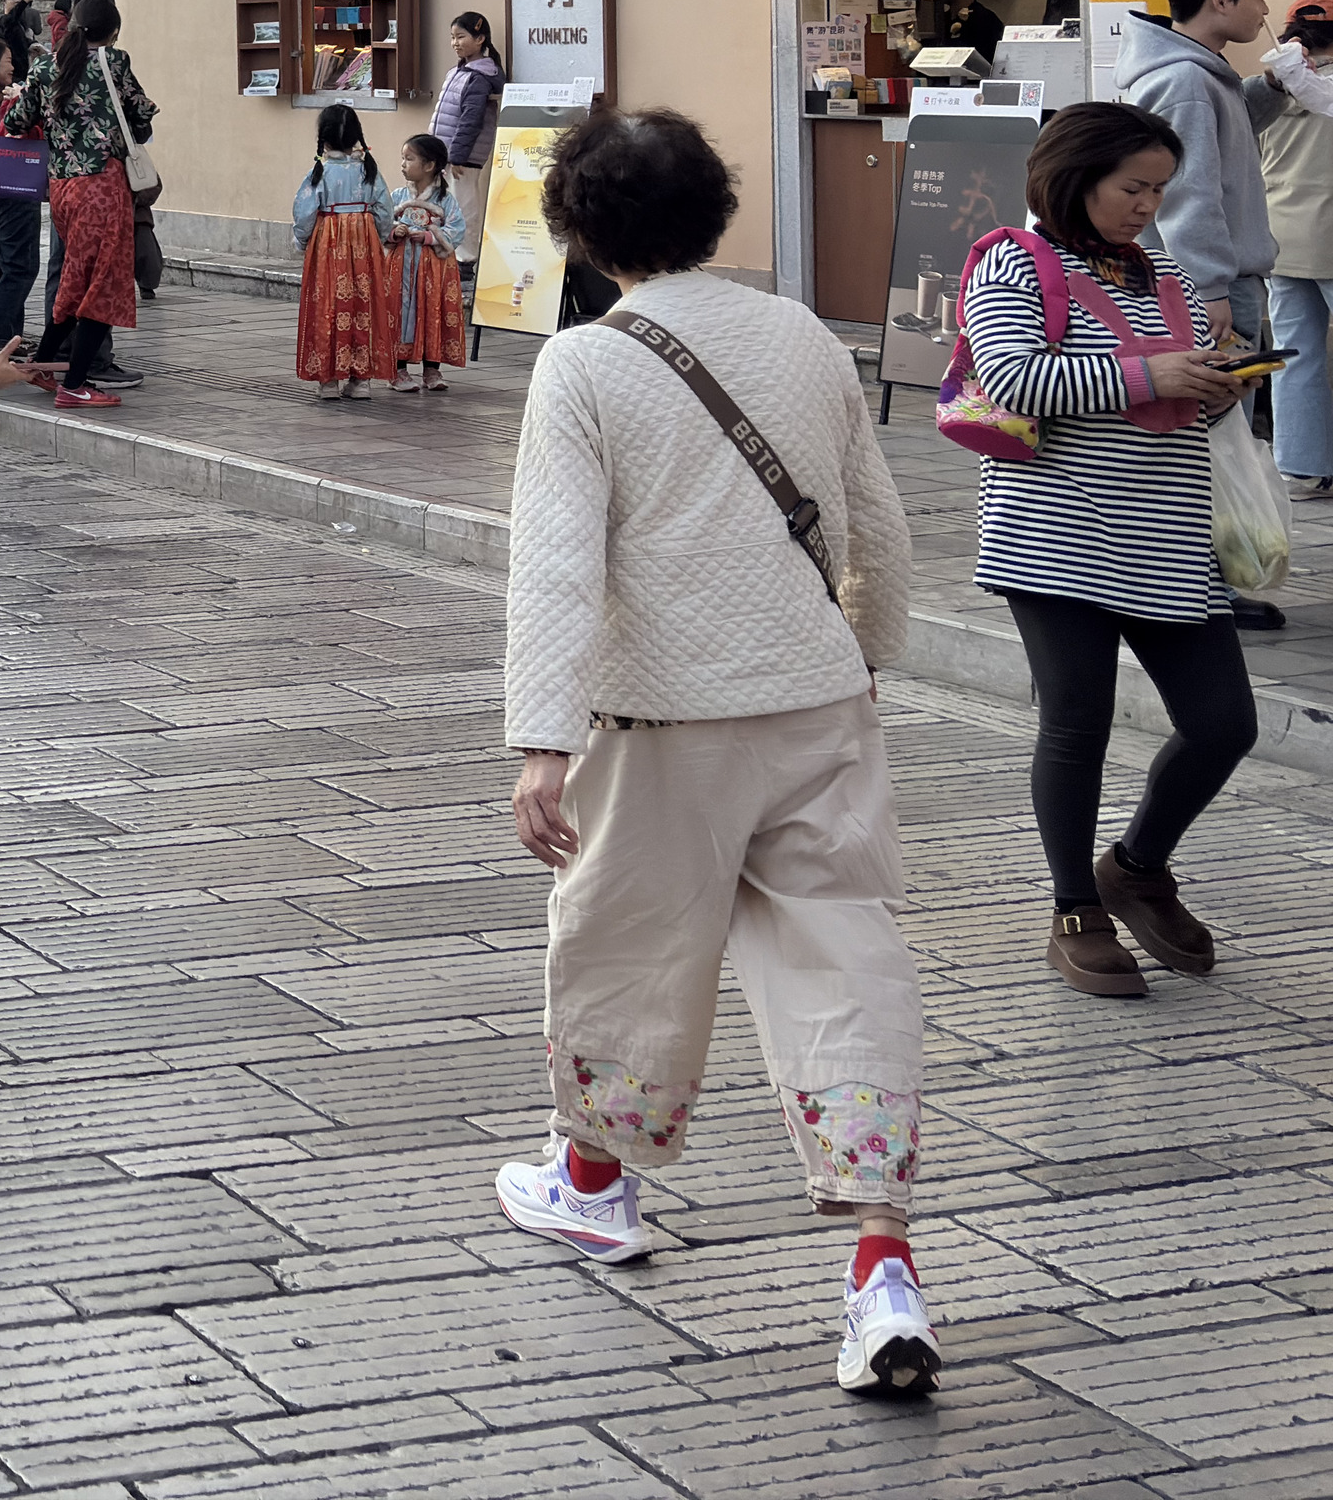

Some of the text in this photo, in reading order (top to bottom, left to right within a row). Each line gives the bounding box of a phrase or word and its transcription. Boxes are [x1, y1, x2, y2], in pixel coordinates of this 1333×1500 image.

[529, 27, 587, 45] KUNMING
[498, 142, 515, 169] 乳
[913, 182, 942, 195] 冬季Top
[628, 318, 695, 372] BSTO
[732, 419, 783, 486] BSTO
